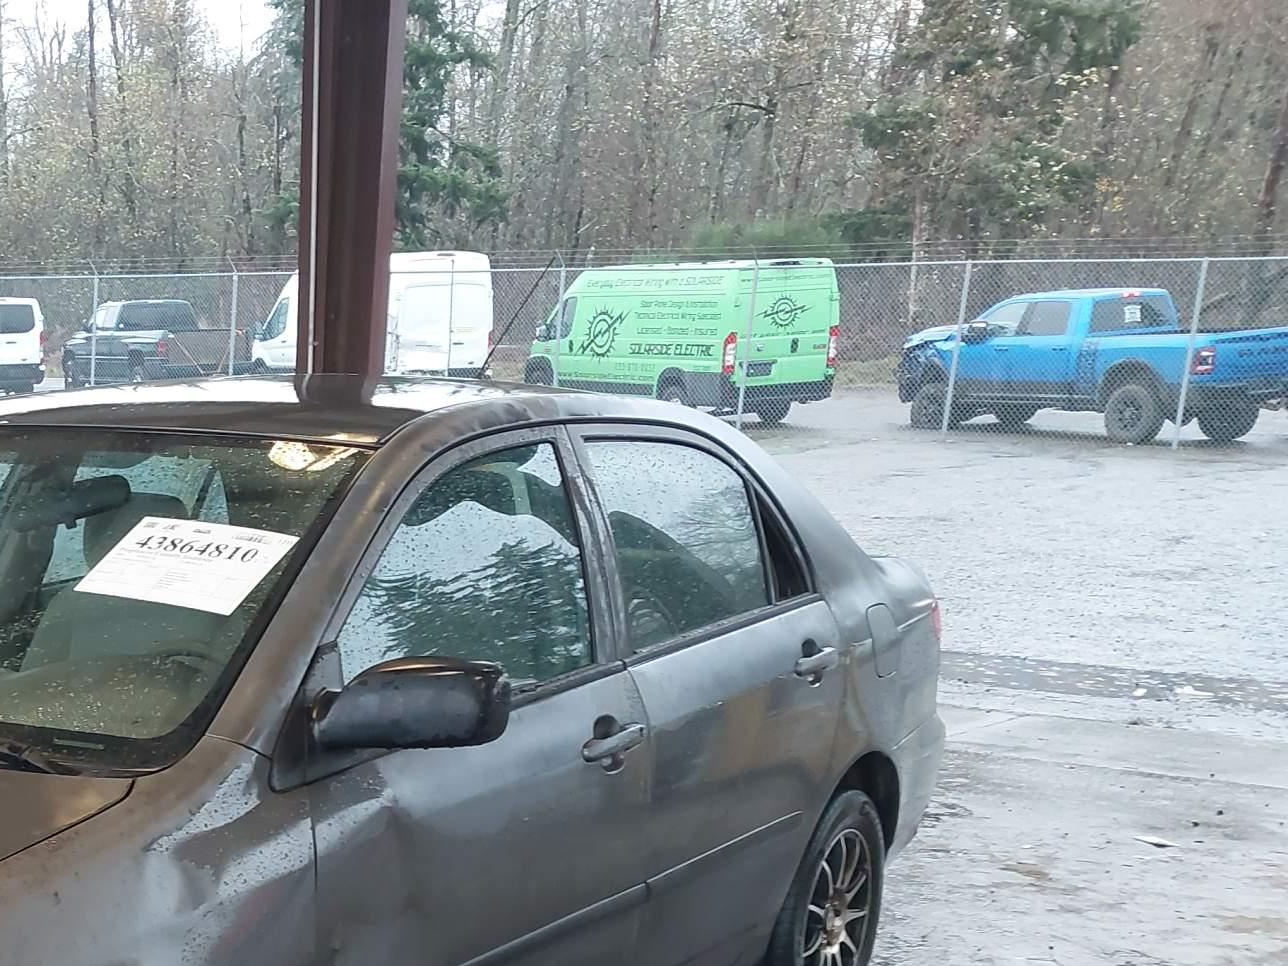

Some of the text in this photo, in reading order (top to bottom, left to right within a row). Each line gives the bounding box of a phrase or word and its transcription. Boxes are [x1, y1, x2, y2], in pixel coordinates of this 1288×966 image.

[629, 343, 714, 357] SOLARSIDE ELECTRIC
[136, 535, 259, 563] 43864810
